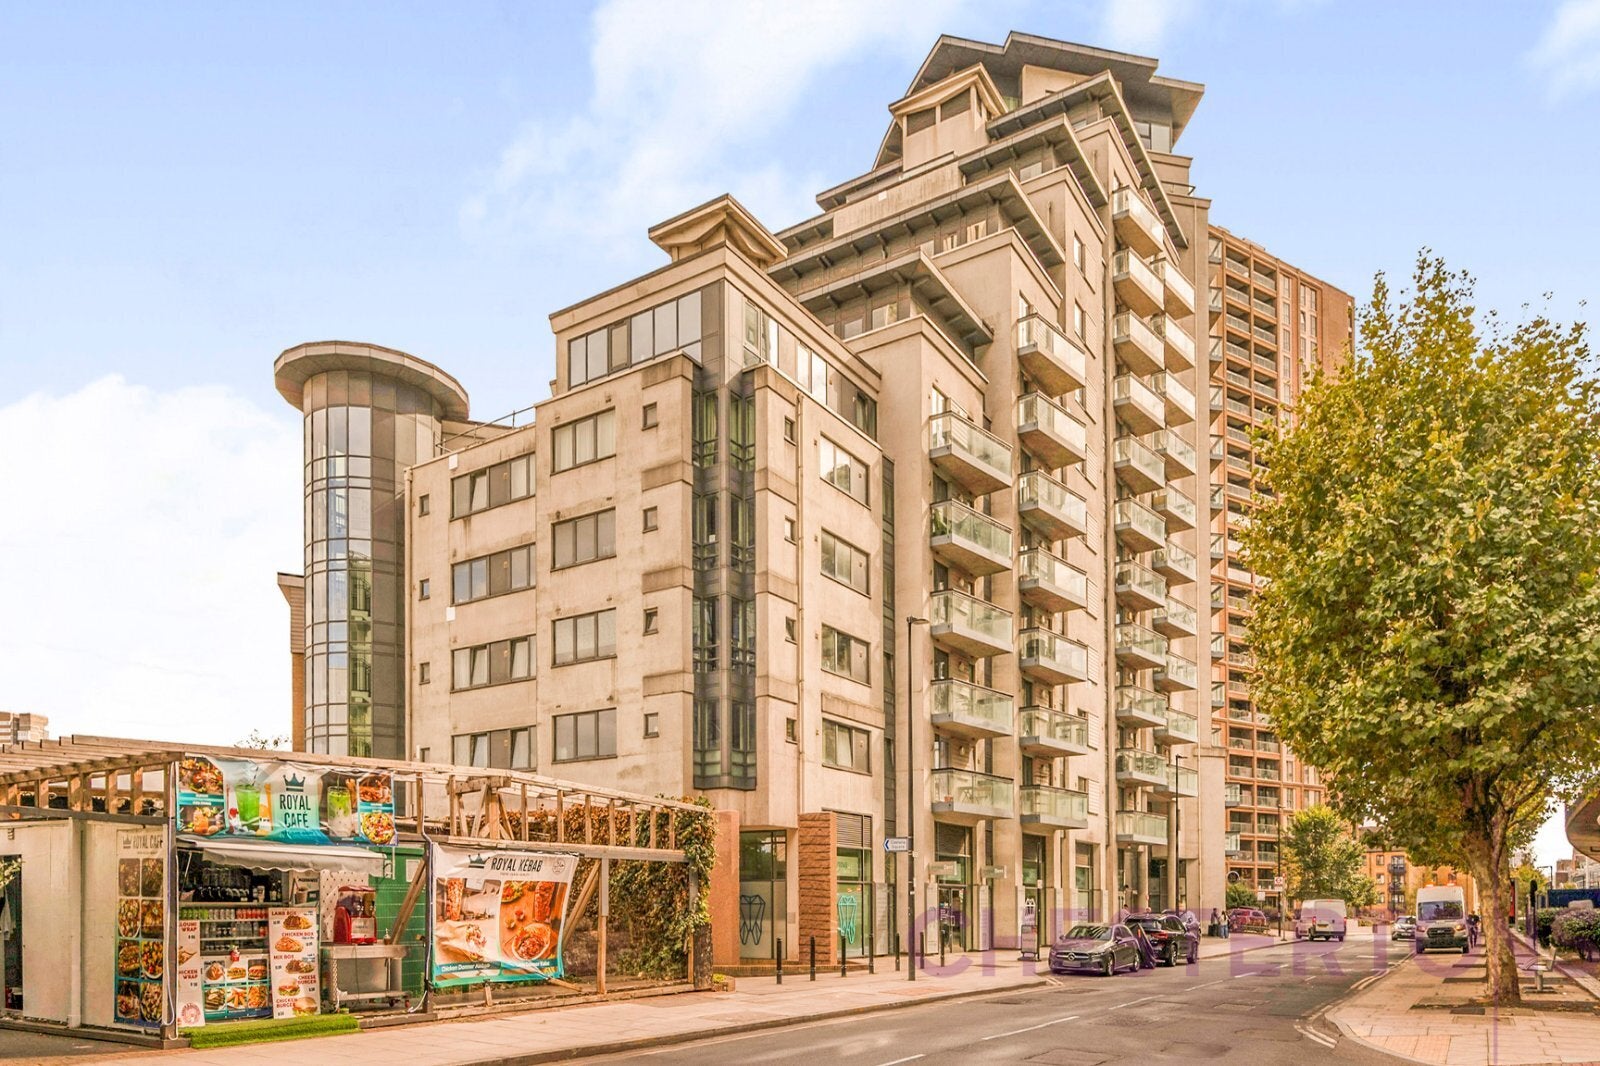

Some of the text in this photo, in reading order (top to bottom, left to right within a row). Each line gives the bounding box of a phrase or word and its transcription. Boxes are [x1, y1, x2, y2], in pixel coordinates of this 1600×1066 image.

[279, 794, 311, 811] ROYAL
[284, 810, 309, 829] CAFÉ
[491, 857, 517, 871] ROYAL
